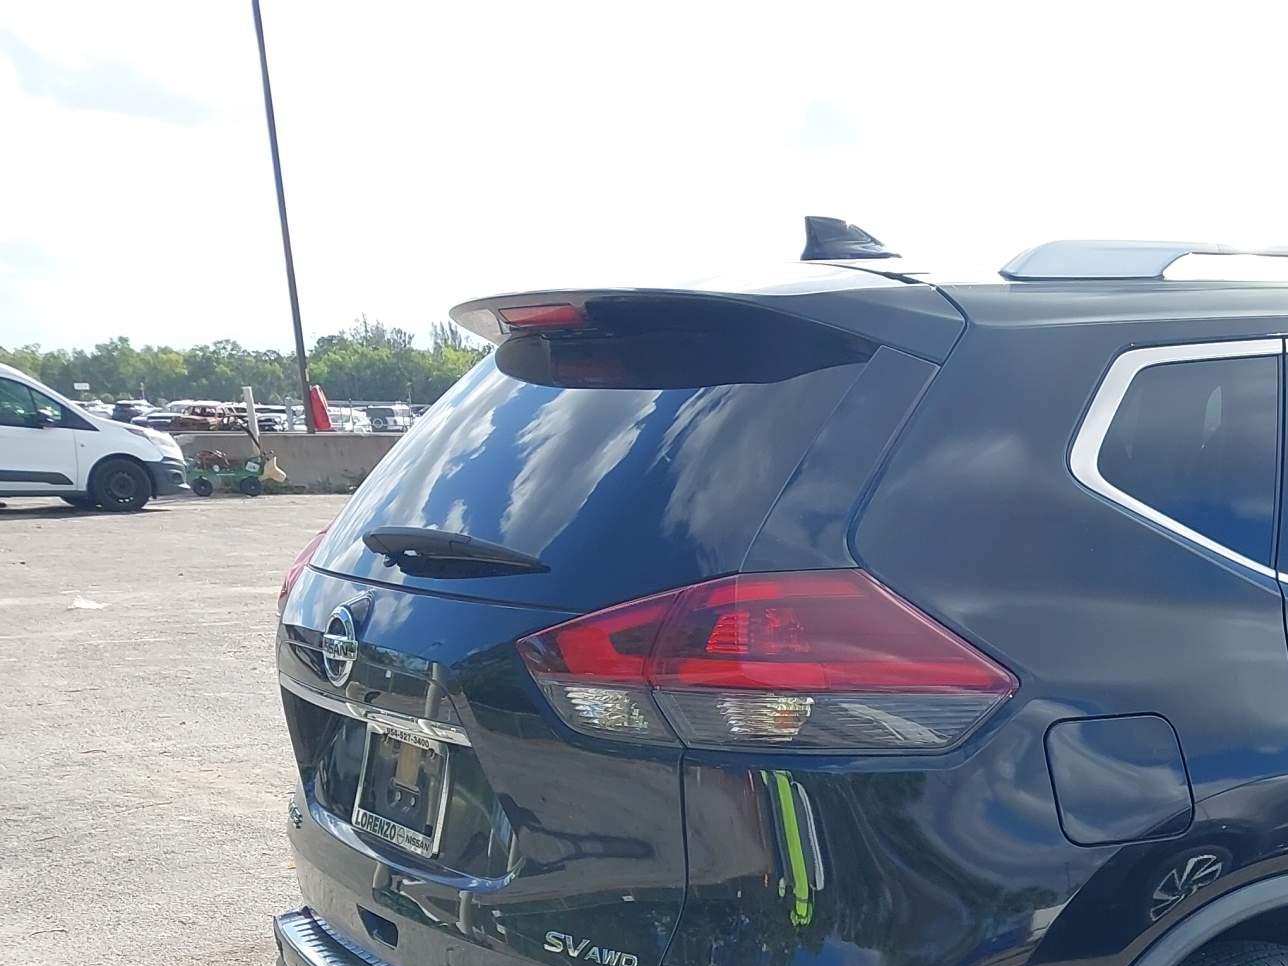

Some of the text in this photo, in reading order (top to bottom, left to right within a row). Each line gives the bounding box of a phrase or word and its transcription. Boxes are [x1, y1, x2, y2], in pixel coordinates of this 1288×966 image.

[354, 809, 431, 852] LORENZO NISSAN
[543, 931, 590, 958] SV
